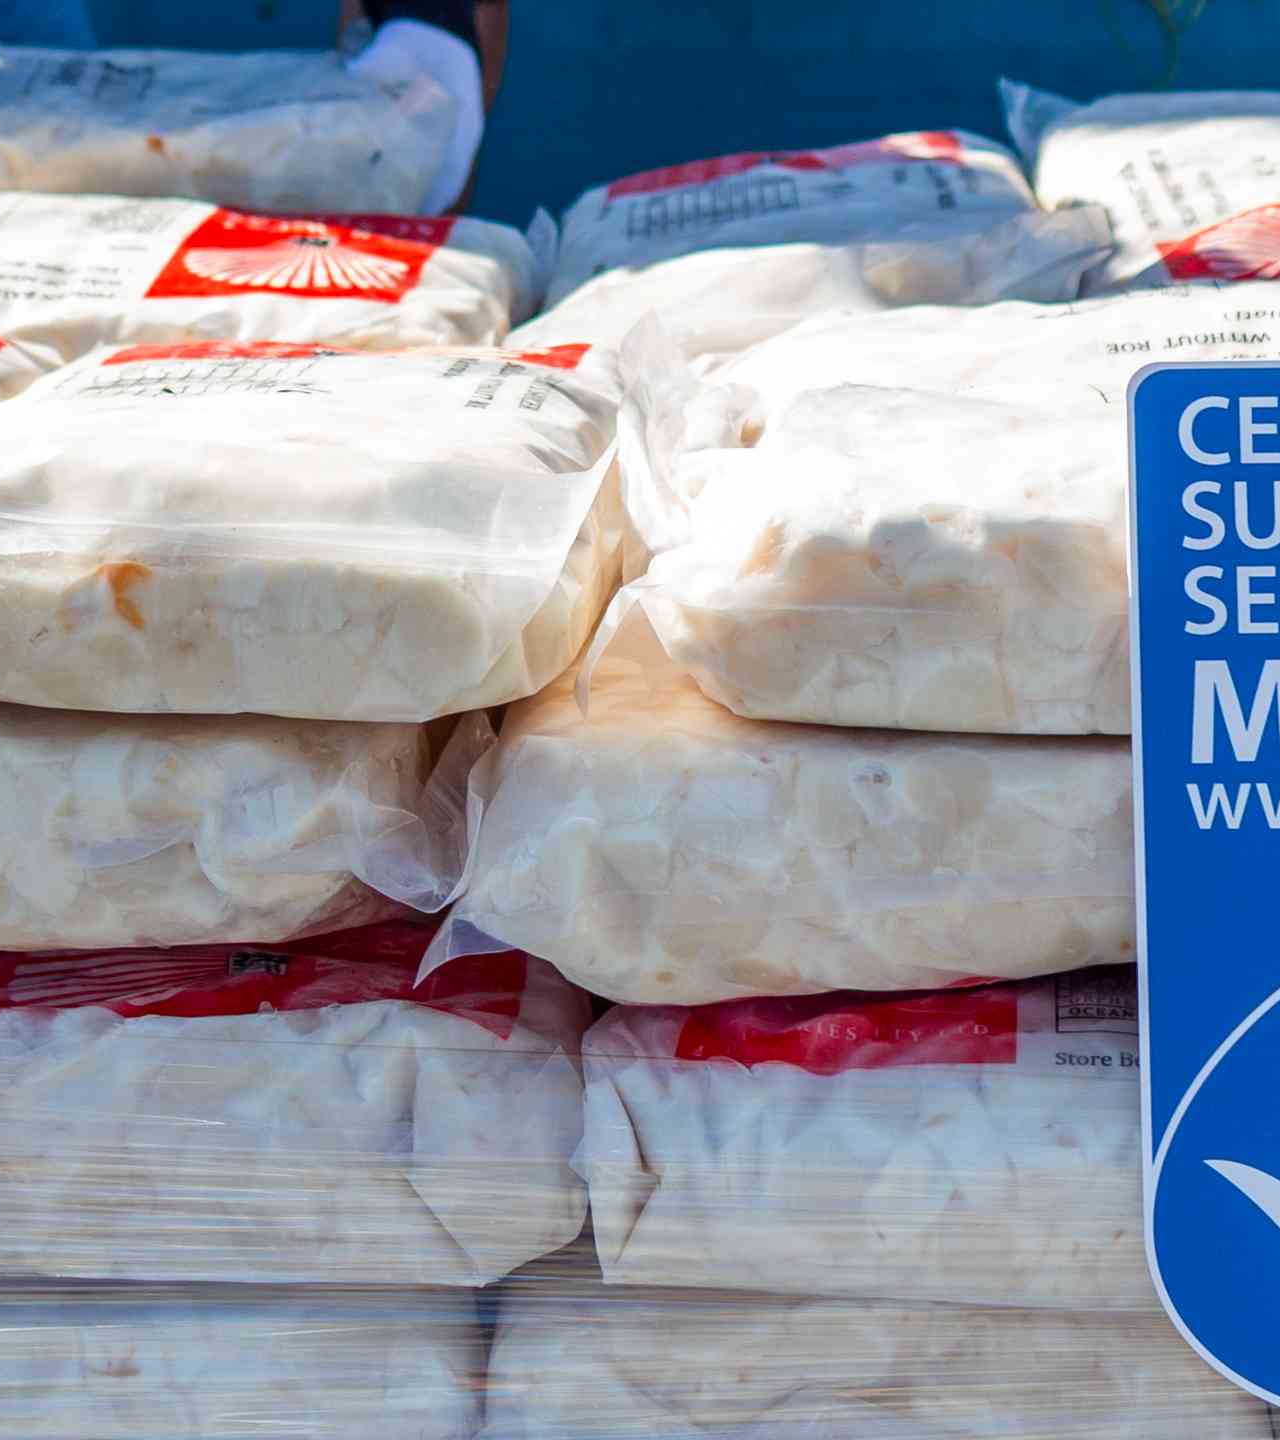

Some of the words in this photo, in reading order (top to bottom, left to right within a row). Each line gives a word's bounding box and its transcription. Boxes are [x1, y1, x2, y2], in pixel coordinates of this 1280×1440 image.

[1105, 343, 1151, 356] ROE
[1163, 332, 1271, 351] WITHOUT
[1055, 1051, 1113, 1067] Store
